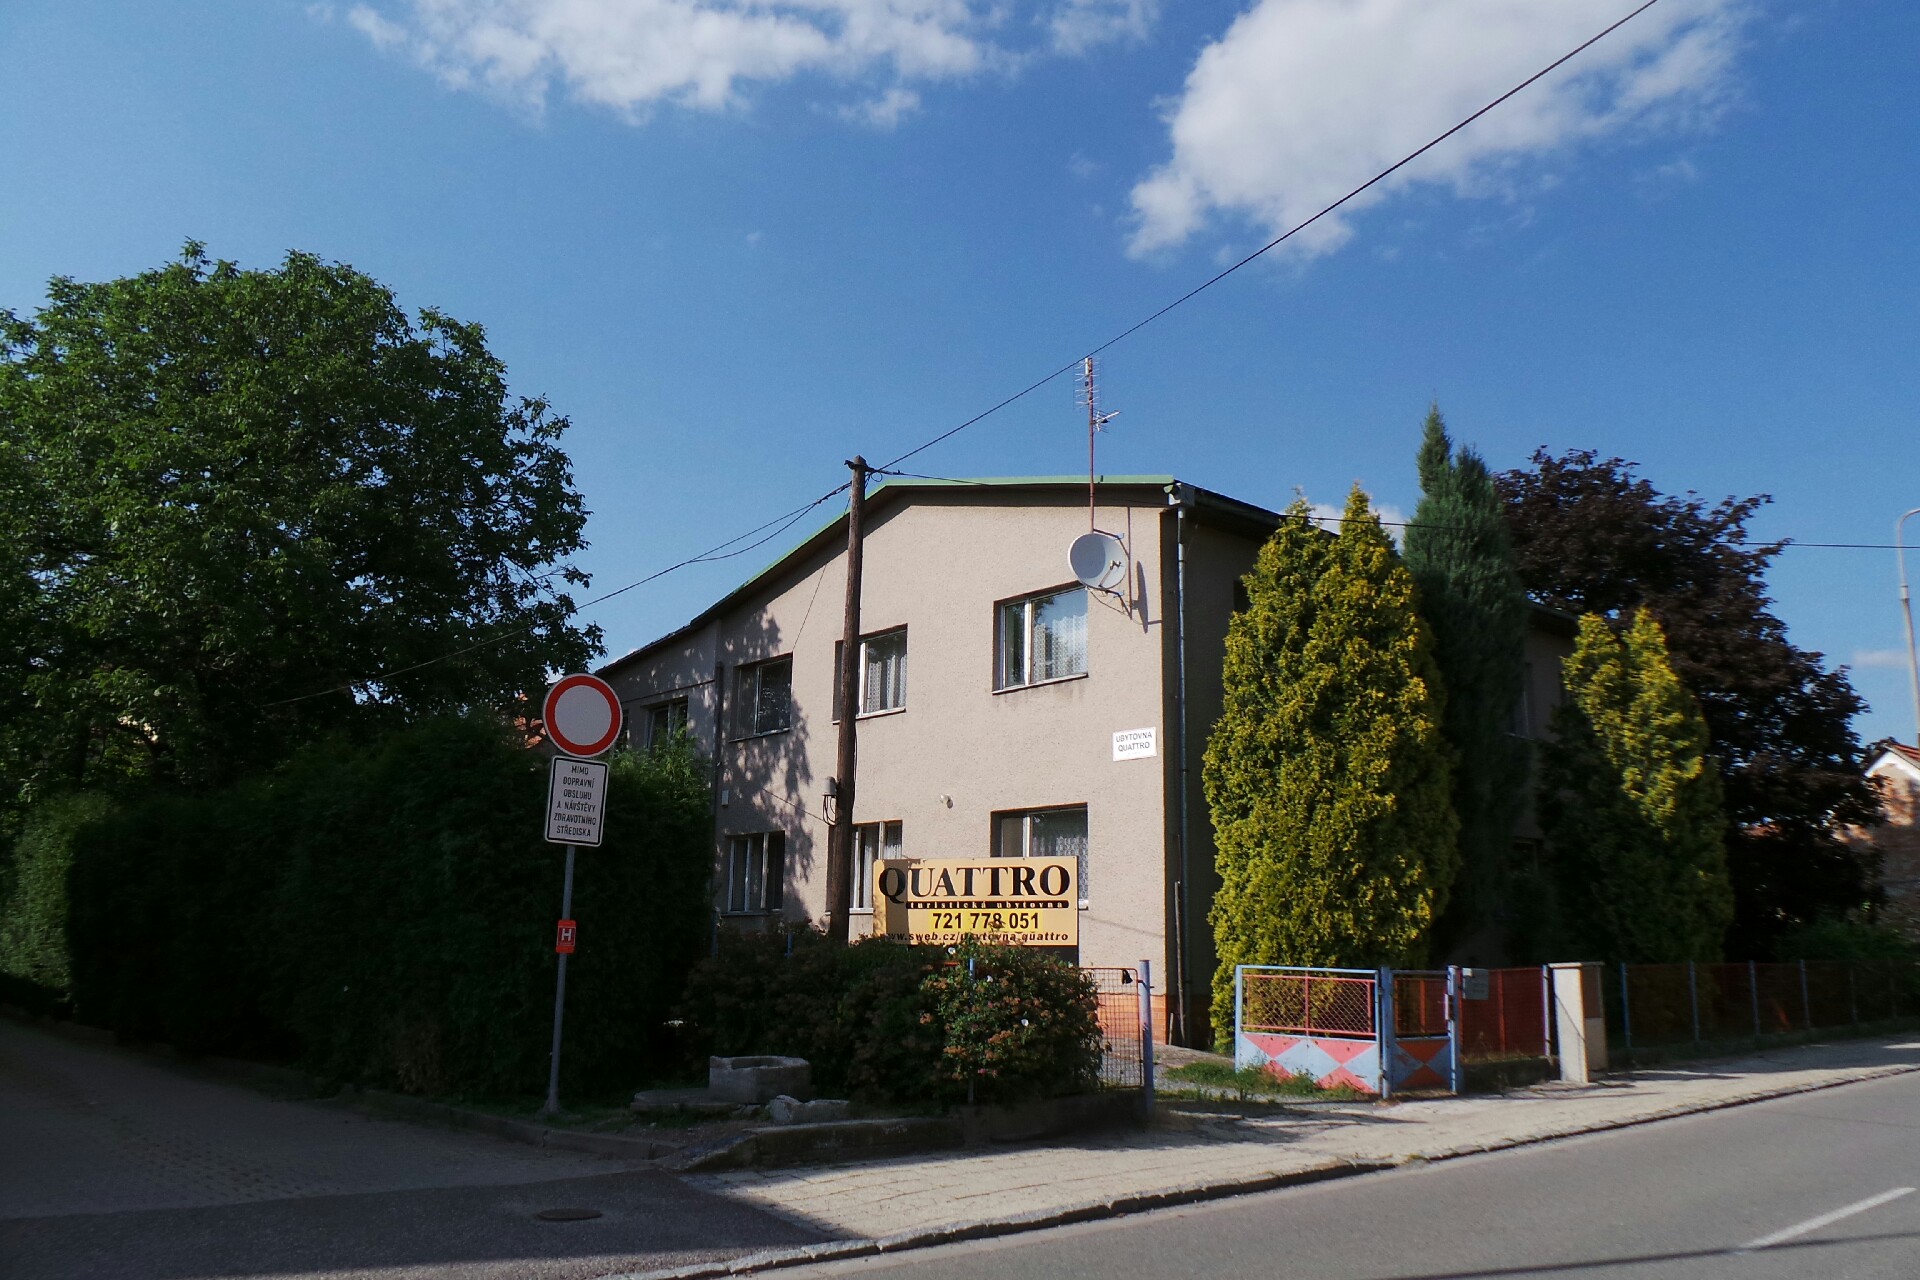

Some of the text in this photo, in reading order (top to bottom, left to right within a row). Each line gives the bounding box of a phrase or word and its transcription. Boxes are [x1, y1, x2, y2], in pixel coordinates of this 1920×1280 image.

[1115, 731, 1152, 743] UBYTOVNA
[1118, 741, 1150, 752] QUATTRO
[571, 765, 589, 775] MIMO
[563, 776, 595, 789] DOPRAVNÍ
[563, 788, 592, 801] OBSLUHU
[556, 799, 596, 813] A NÁVŠTĚVY
[554, 812, 597, 826] ZDRAVOTNÍHO
[556, 824, 591, 837] STŘEDISKA
[878, 864, 1071, 904] QUATTRO
[996, 901, 1063, 909] ubytovna
[932, 912, 1039, 929] 721 778 051
[561, 928, 572, 941] H
[882, 931, 1069, 943] ww.sweb.cz/uytovnaquattro
